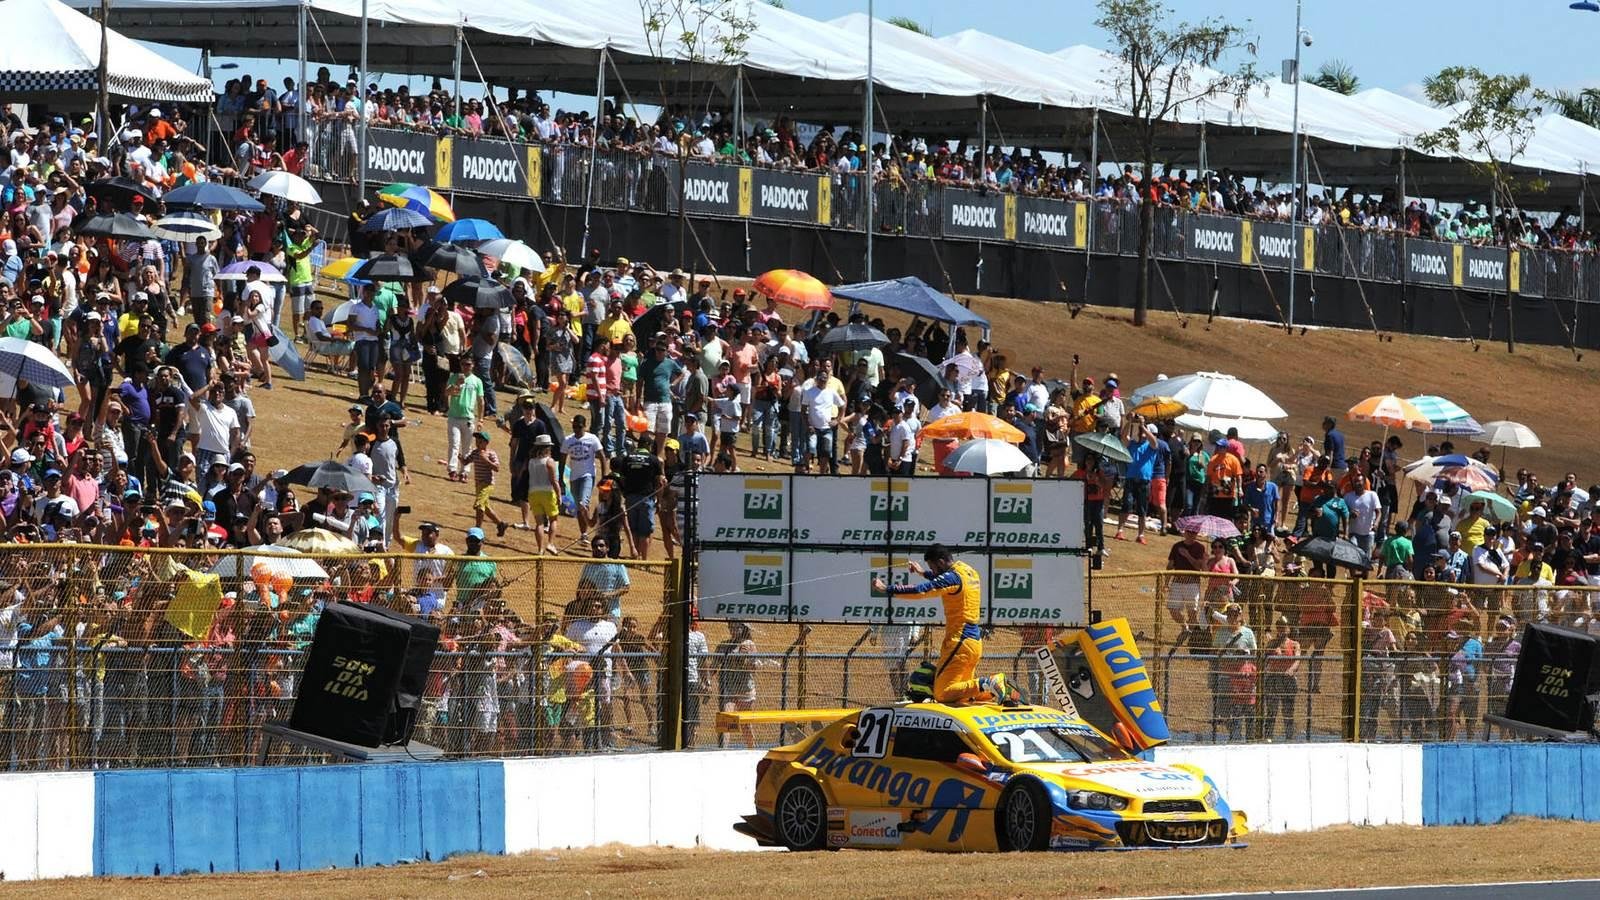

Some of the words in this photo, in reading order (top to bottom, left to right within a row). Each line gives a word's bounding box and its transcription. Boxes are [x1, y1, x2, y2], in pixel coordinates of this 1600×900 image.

[368, 145, 425, 175] PADDOCK
[463, 155, 517, 183] PADDOCK
[761, 184, 808, 211] PADDOCK
[952, 204, 997, 229] PADDOCK
[1024, 211, 1068, 236] PADDOCK
[1194, 228, 1234, 253] PADDOCK
[1411, 252, 1447, 275] PADDOCK
[1469, 258, 1504, 281] PADDOCK
[747, 492, 778, 510] BR
[873, 495, 906, 512] BR
[997, 497, 1029, 514] BR
[715, 527, 811, 540] PETROBRAS
[841, 529, 938, 542] PETROBRAS
[964, 531, 1061, 544] PETROBRAS
[747, 569, 778, 586] BR
[997, 573, 1029, 589] BR
[716, 603, 810, 616] PETROBRAS
[841, 606, 938, 618] PETROBRAS
[979, 607, 1062, 619] ETROBRAS
[1541, 664, 1573, 677] SOM
[1545, 676, 1564, 687] DA
[1536, 684, 1569, 698] ILHA
[895, 714, 954, 729] T.CAMILO
[972, 713, 1077, 727] Ipiranga
[854, 713, 889, 754] 21
[990, 729, 1064, 763] 21
[798, 737, 931, 806] Ipiranga
